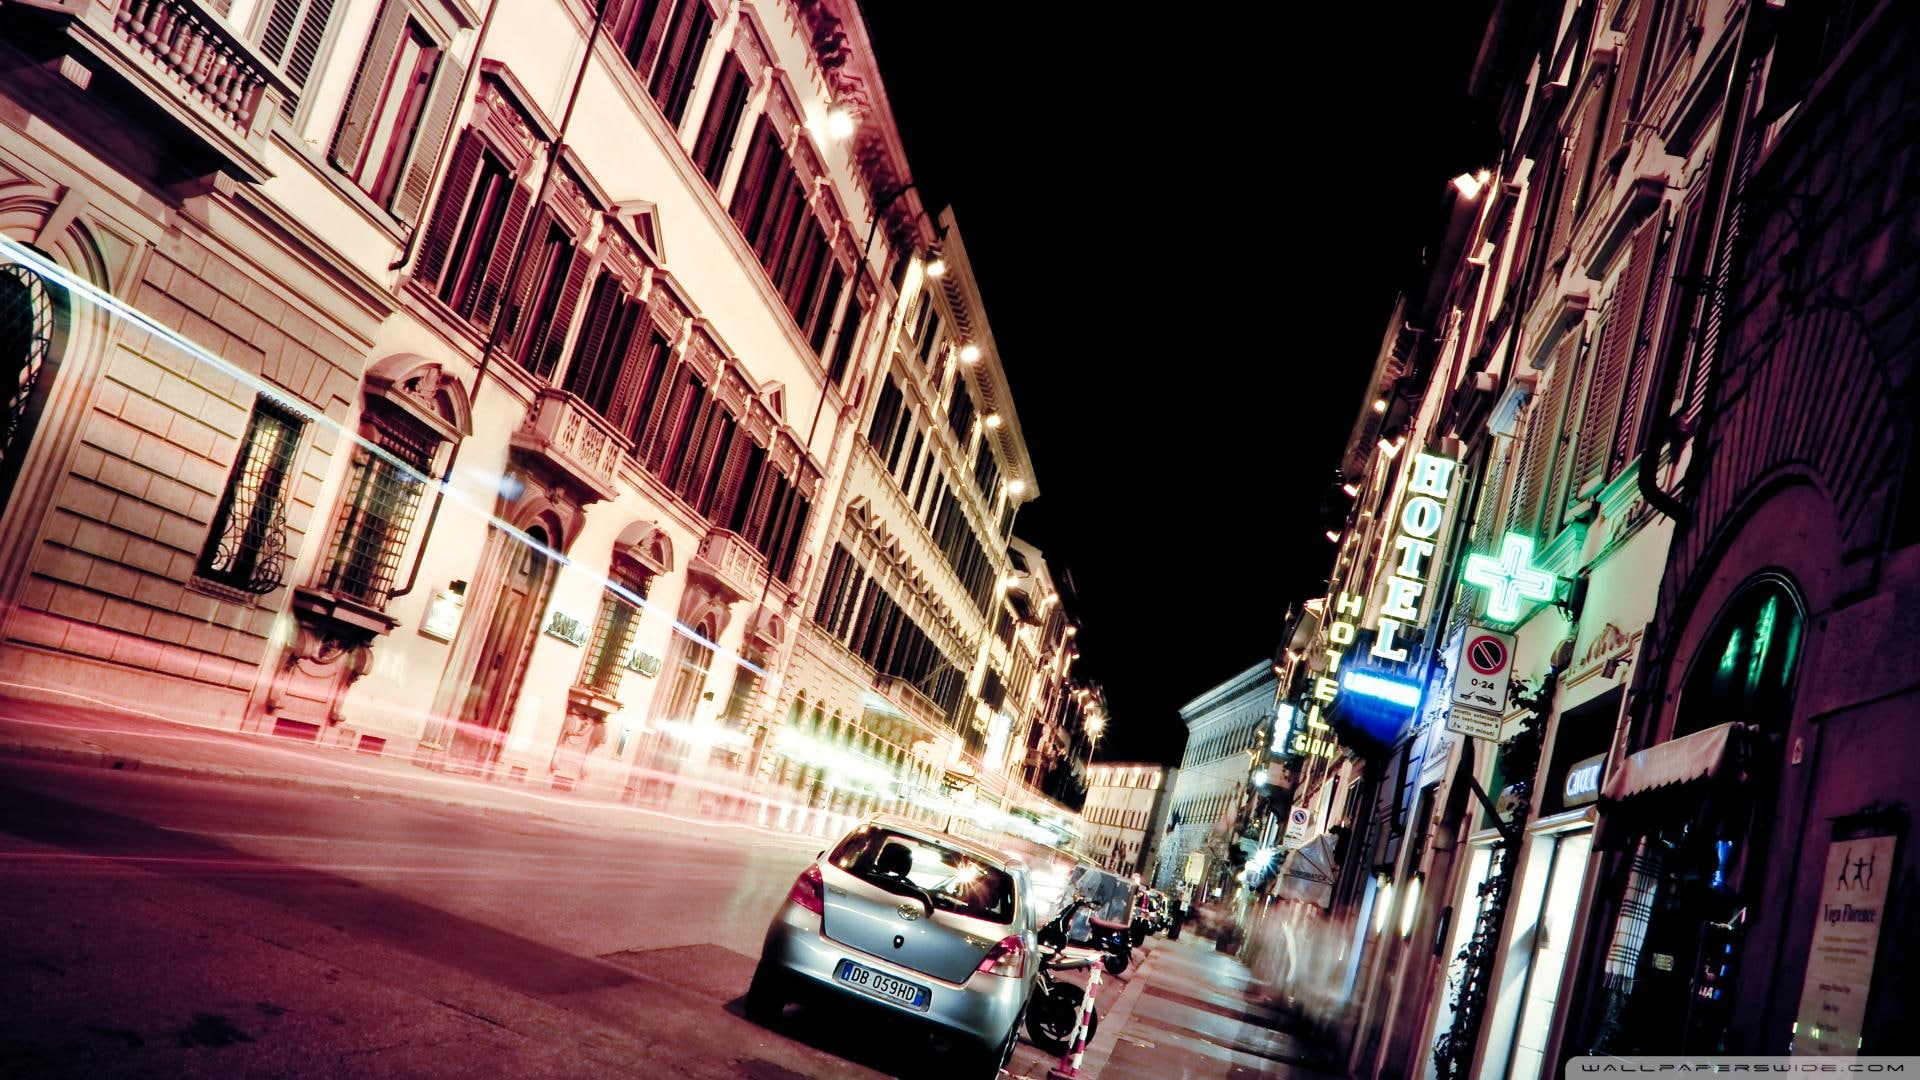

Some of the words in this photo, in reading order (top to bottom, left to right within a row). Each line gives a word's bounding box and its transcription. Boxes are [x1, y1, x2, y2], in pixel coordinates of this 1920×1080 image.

[1371, 453, 1455, 662] HOTEL
[1307, 592, 1361, 731] HOTEL
[1471, 678, 1495, 690] 0-24
[851, 967, 870, 985] DB
[872, 975, 916, 1001] 059HD
